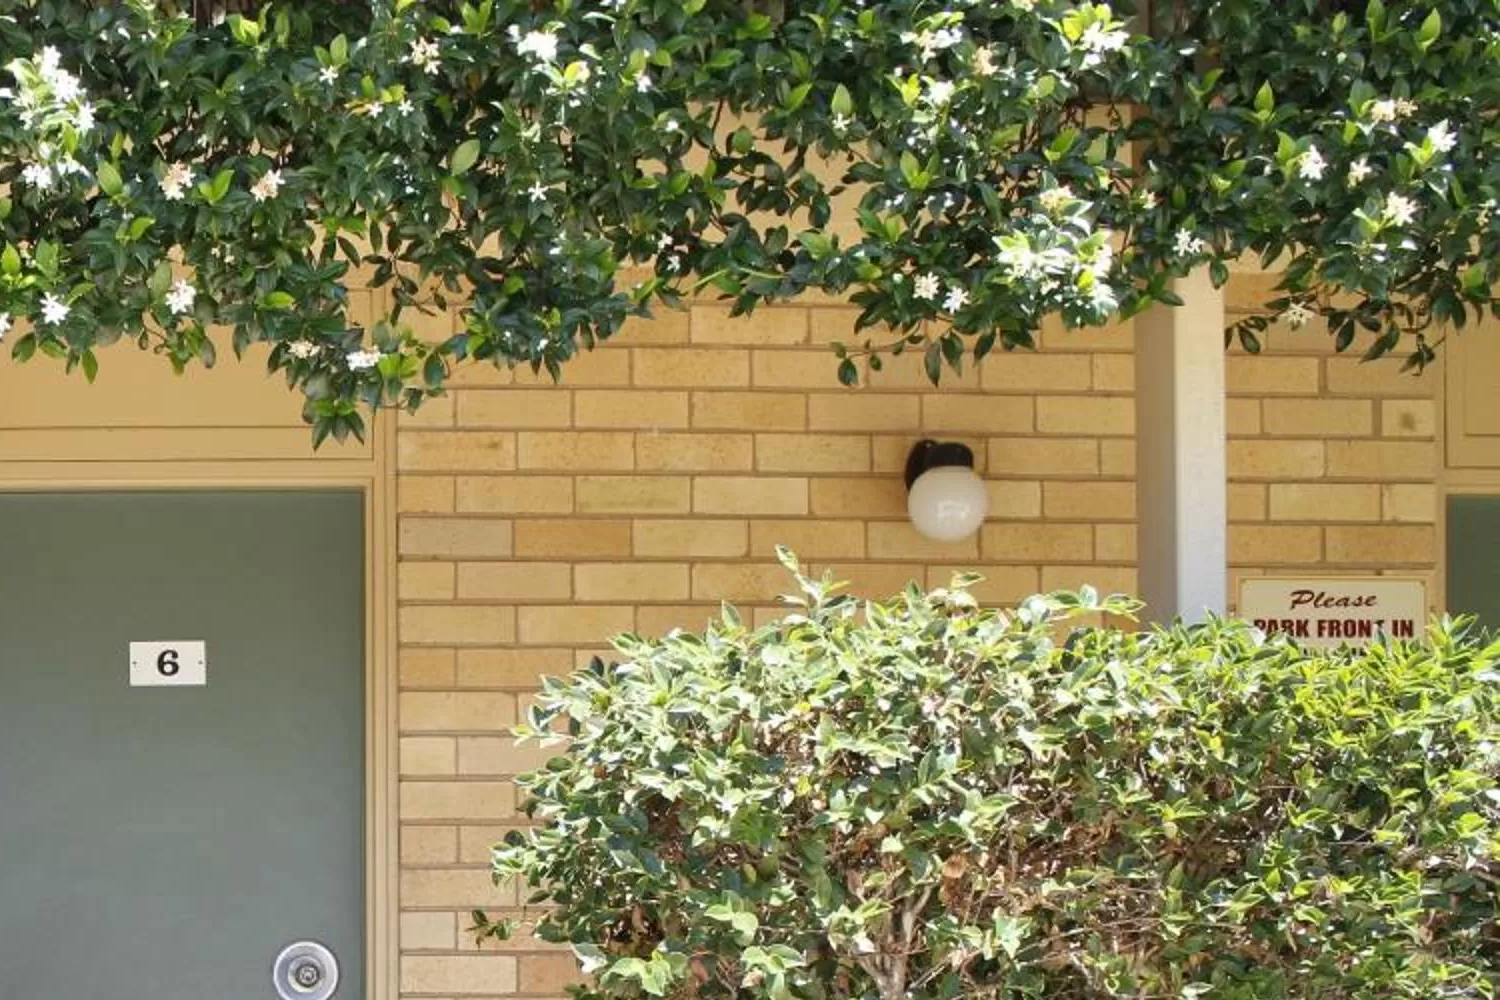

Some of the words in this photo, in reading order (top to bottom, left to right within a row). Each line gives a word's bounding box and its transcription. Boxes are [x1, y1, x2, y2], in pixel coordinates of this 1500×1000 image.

[1290, 589, 1377, 610] Please
[1254, 619, 1310, 638] PARK
[1392, 619, 1414, 638] IN
[157, 649, 180, 677] 6
